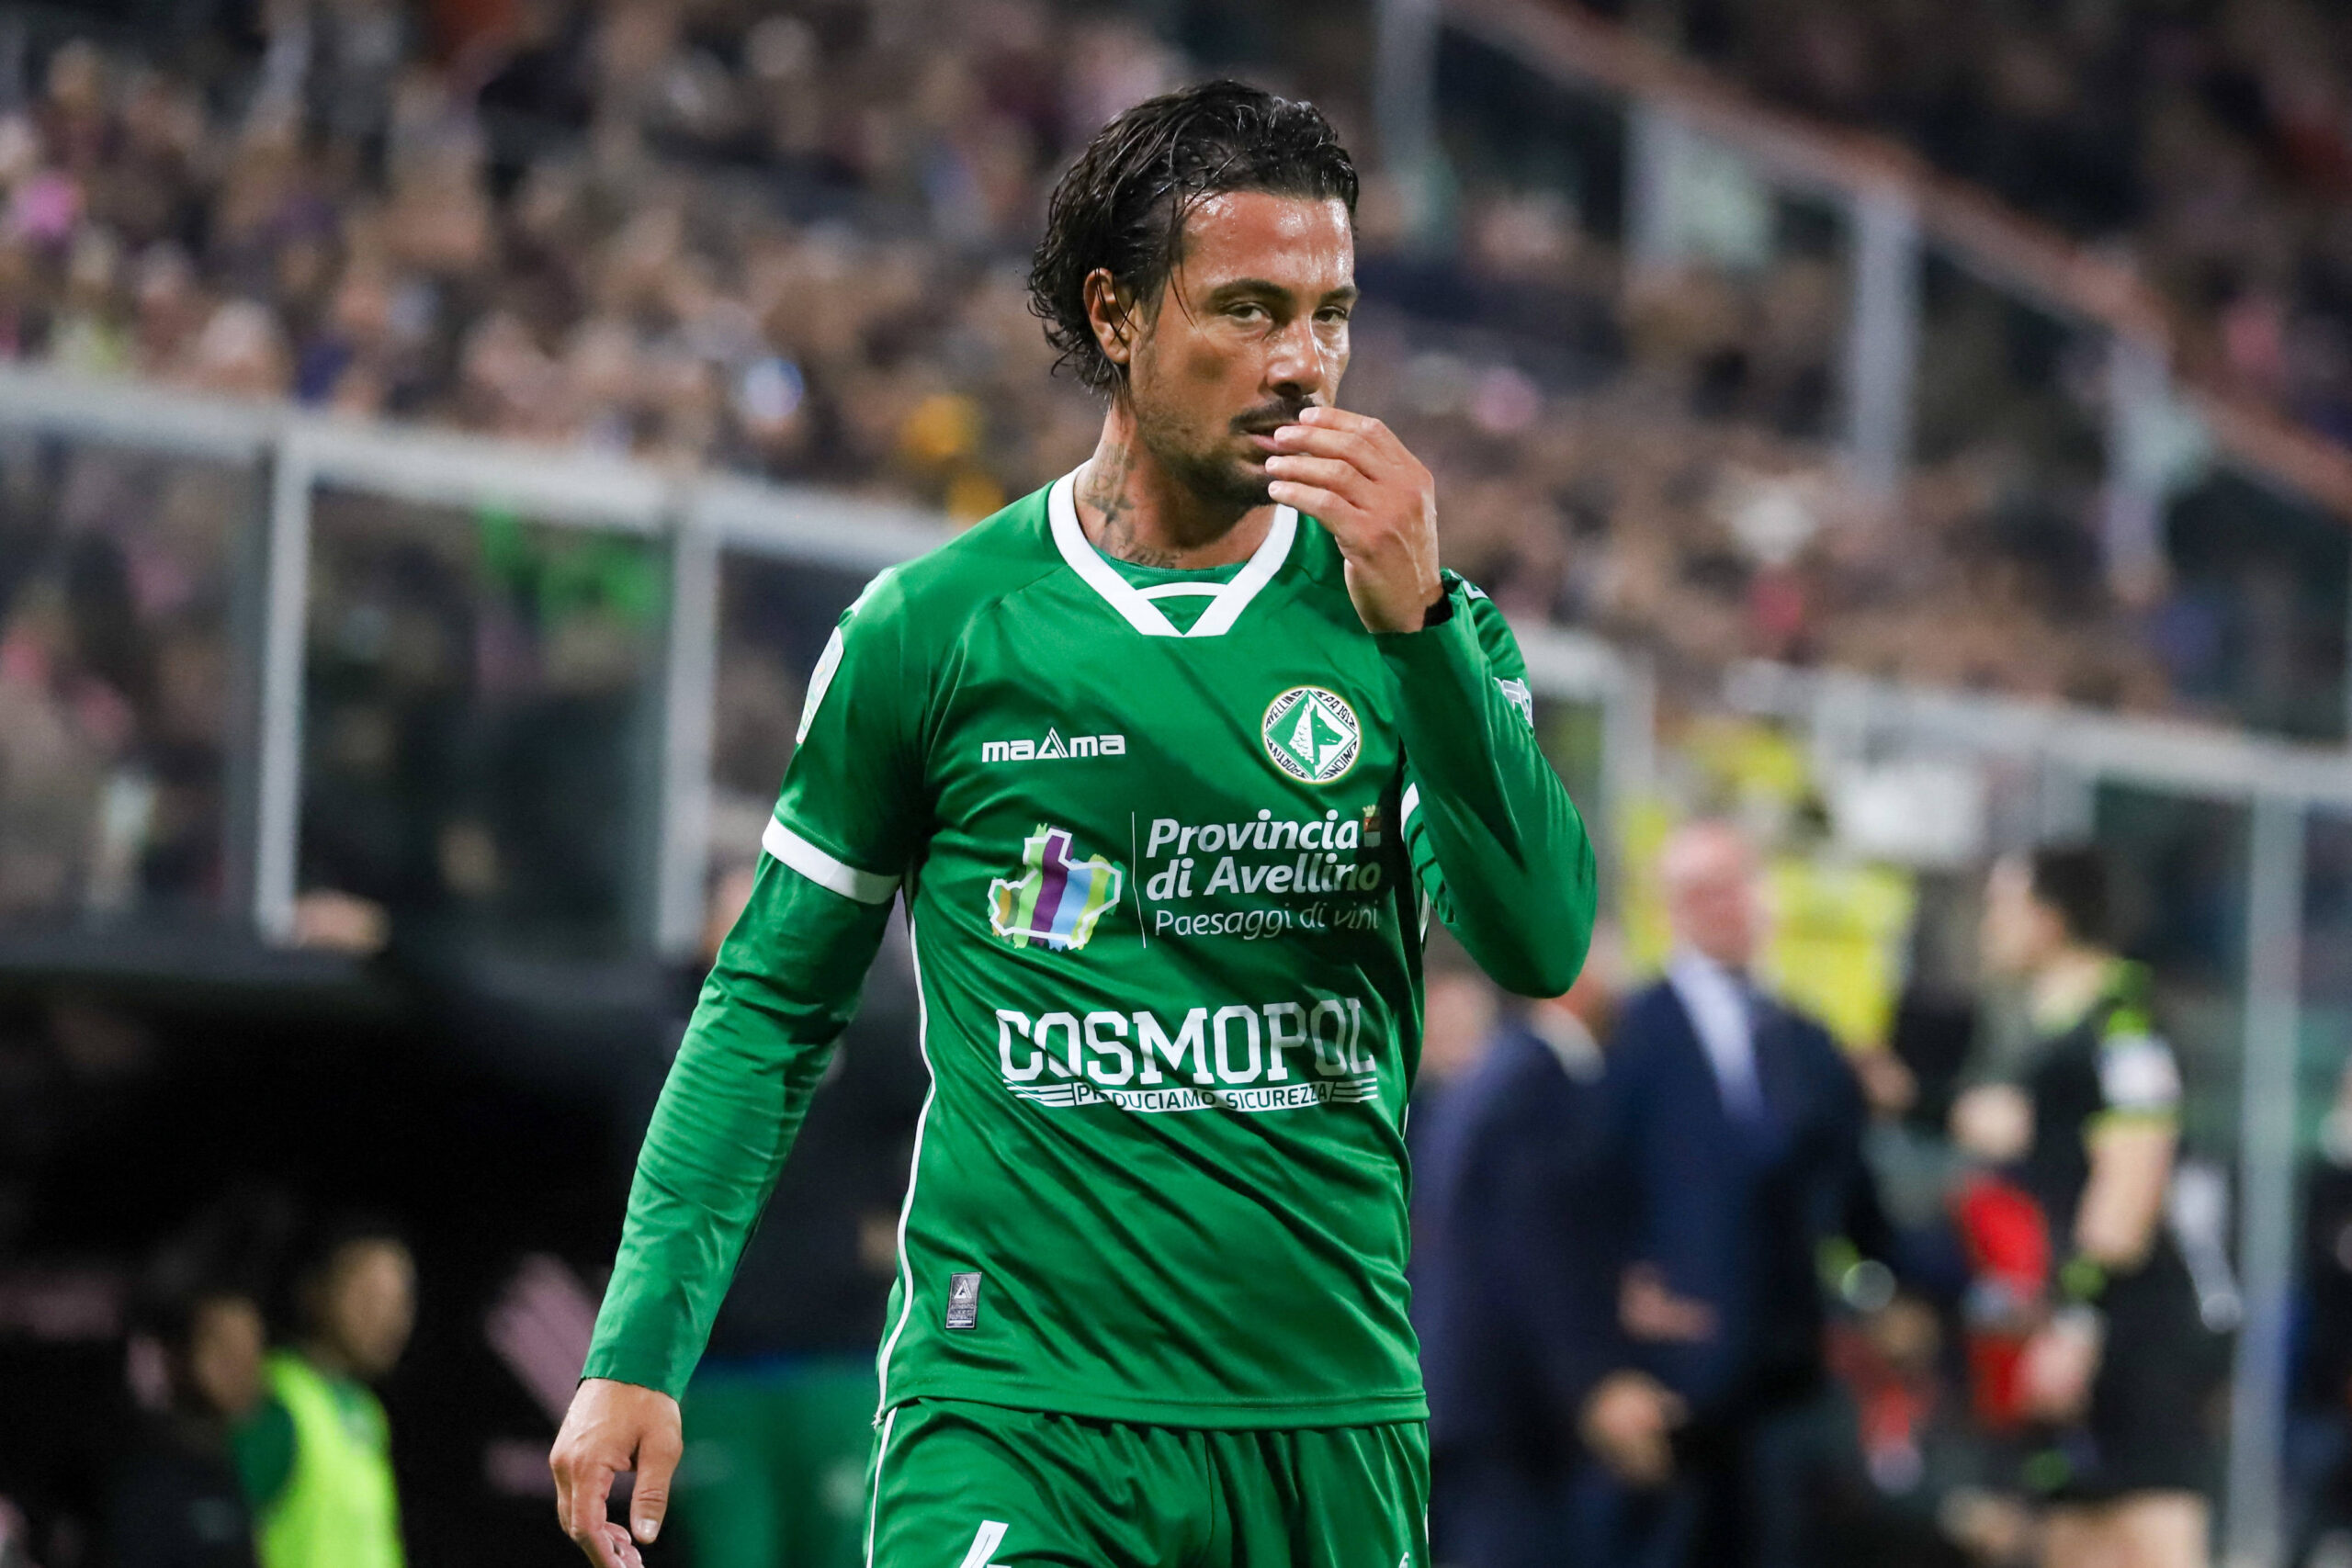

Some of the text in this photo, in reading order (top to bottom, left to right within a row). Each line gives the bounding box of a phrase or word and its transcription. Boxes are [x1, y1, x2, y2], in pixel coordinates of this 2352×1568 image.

[1265, 689, 1304, 728] AVELLINO
[1266, 738, 1358, 779] UNIONE SPORTIVA
[1147, 808, 1359, 858] Provincia
[1146, 852, 1381, 901] di Avellino
[1155, 900, 1378, 941] Paesaggi di vini
[996, 998, 1376, 1086] COSMOPOL
[1226, 1084, 1328, 1110] SICUREZZA
